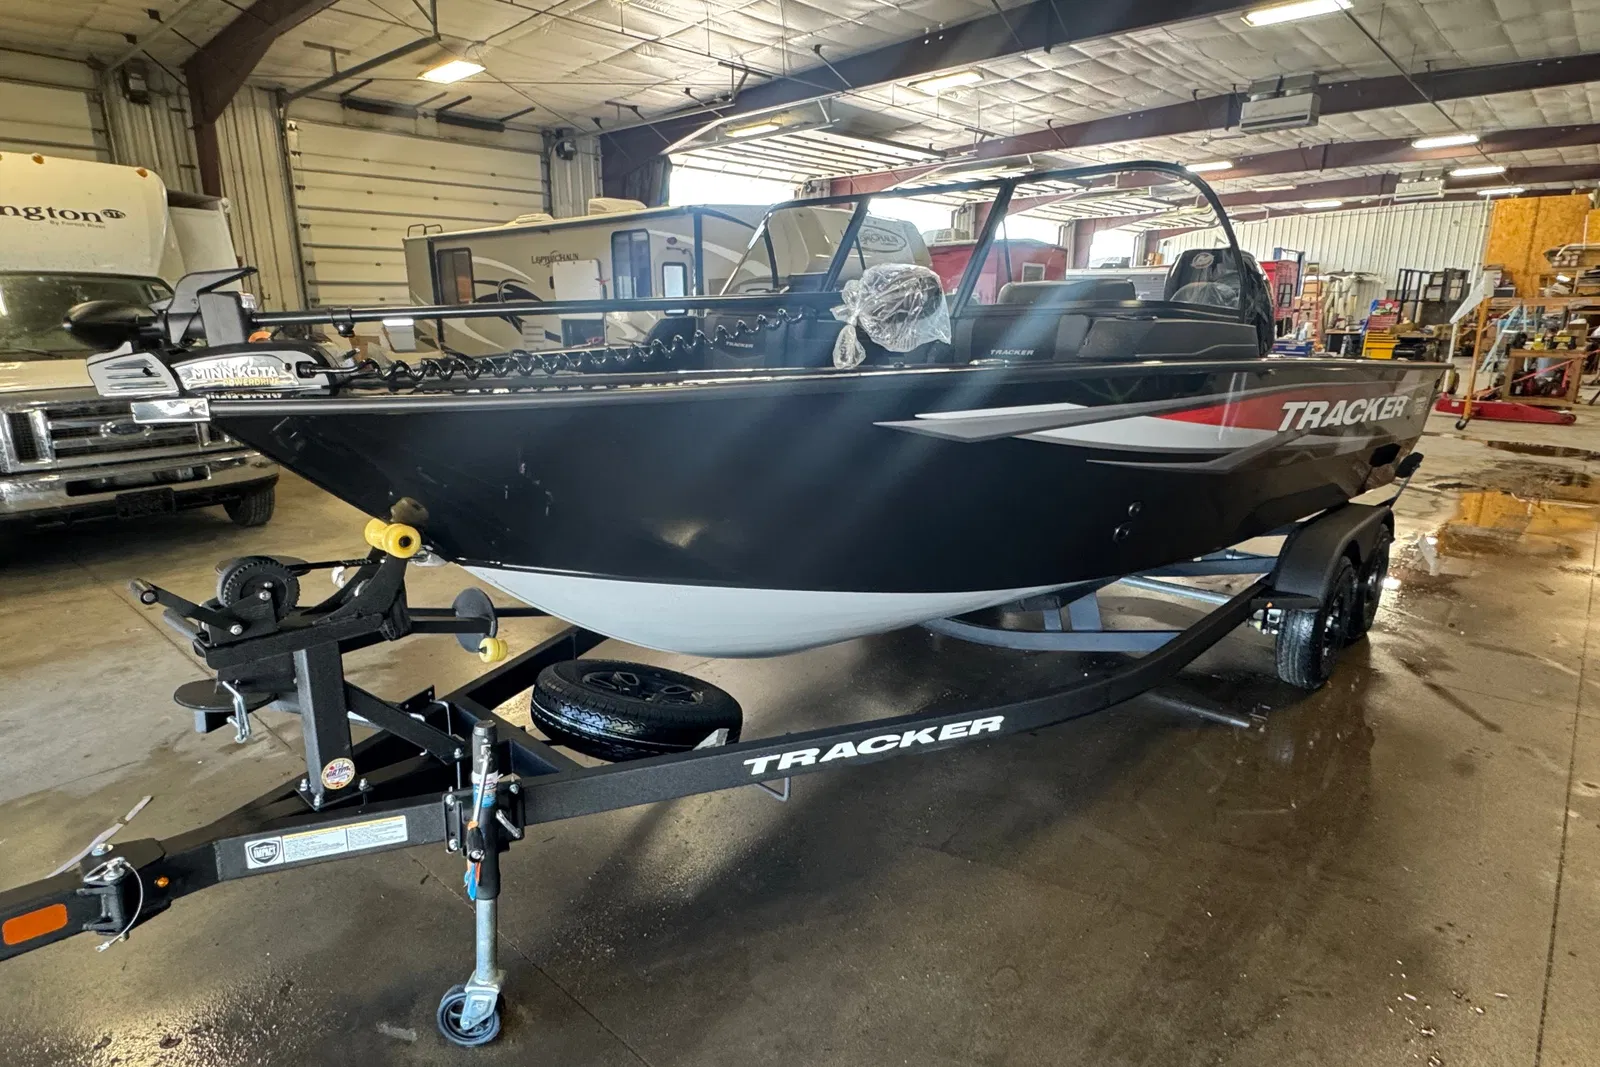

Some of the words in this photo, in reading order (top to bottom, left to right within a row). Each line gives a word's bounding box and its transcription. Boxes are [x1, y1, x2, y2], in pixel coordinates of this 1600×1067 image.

[222, 377, 281, 387] POWERDRIVE
[236, 365, 279, 378] KOTA
[1277, 395, 1410, 432] TRACKER
[743, 715, 1005, 775] TRACKER
